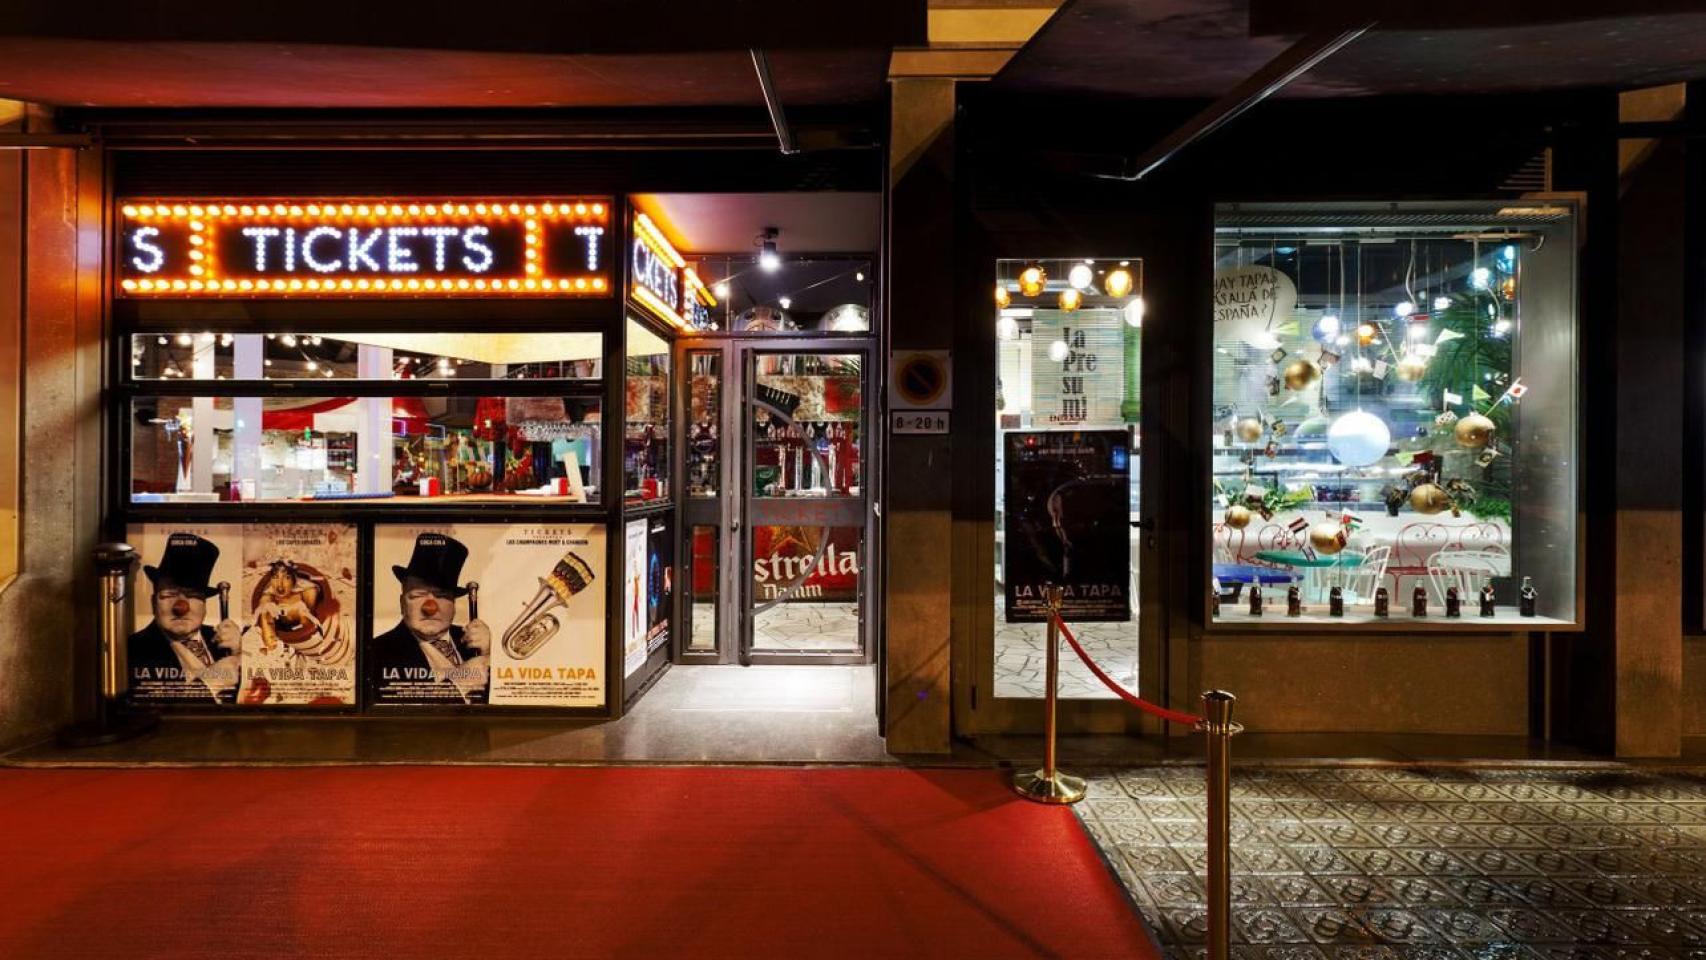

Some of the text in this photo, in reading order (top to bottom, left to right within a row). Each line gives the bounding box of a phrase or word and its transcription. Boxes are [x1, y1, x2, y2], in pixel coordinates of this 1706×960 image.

[132, 225, 604, 273] S TICKETS T
[1063, 327, 1085, 348] La
[1063, 351, 1097, 372] Pre
[1063, 376, 1084, 394] su
[754, 543, 859, 582] strella
[1015, 585, 1033, 597] LA
[1080, 584, 1122, 597] TAPA
[134, 667, 151, 679] LA
[269, 667, 305, 681] VIDA
[383, 667, 400, 679] LA
[497, 667, 596, 680] LA VIDA TAPA
